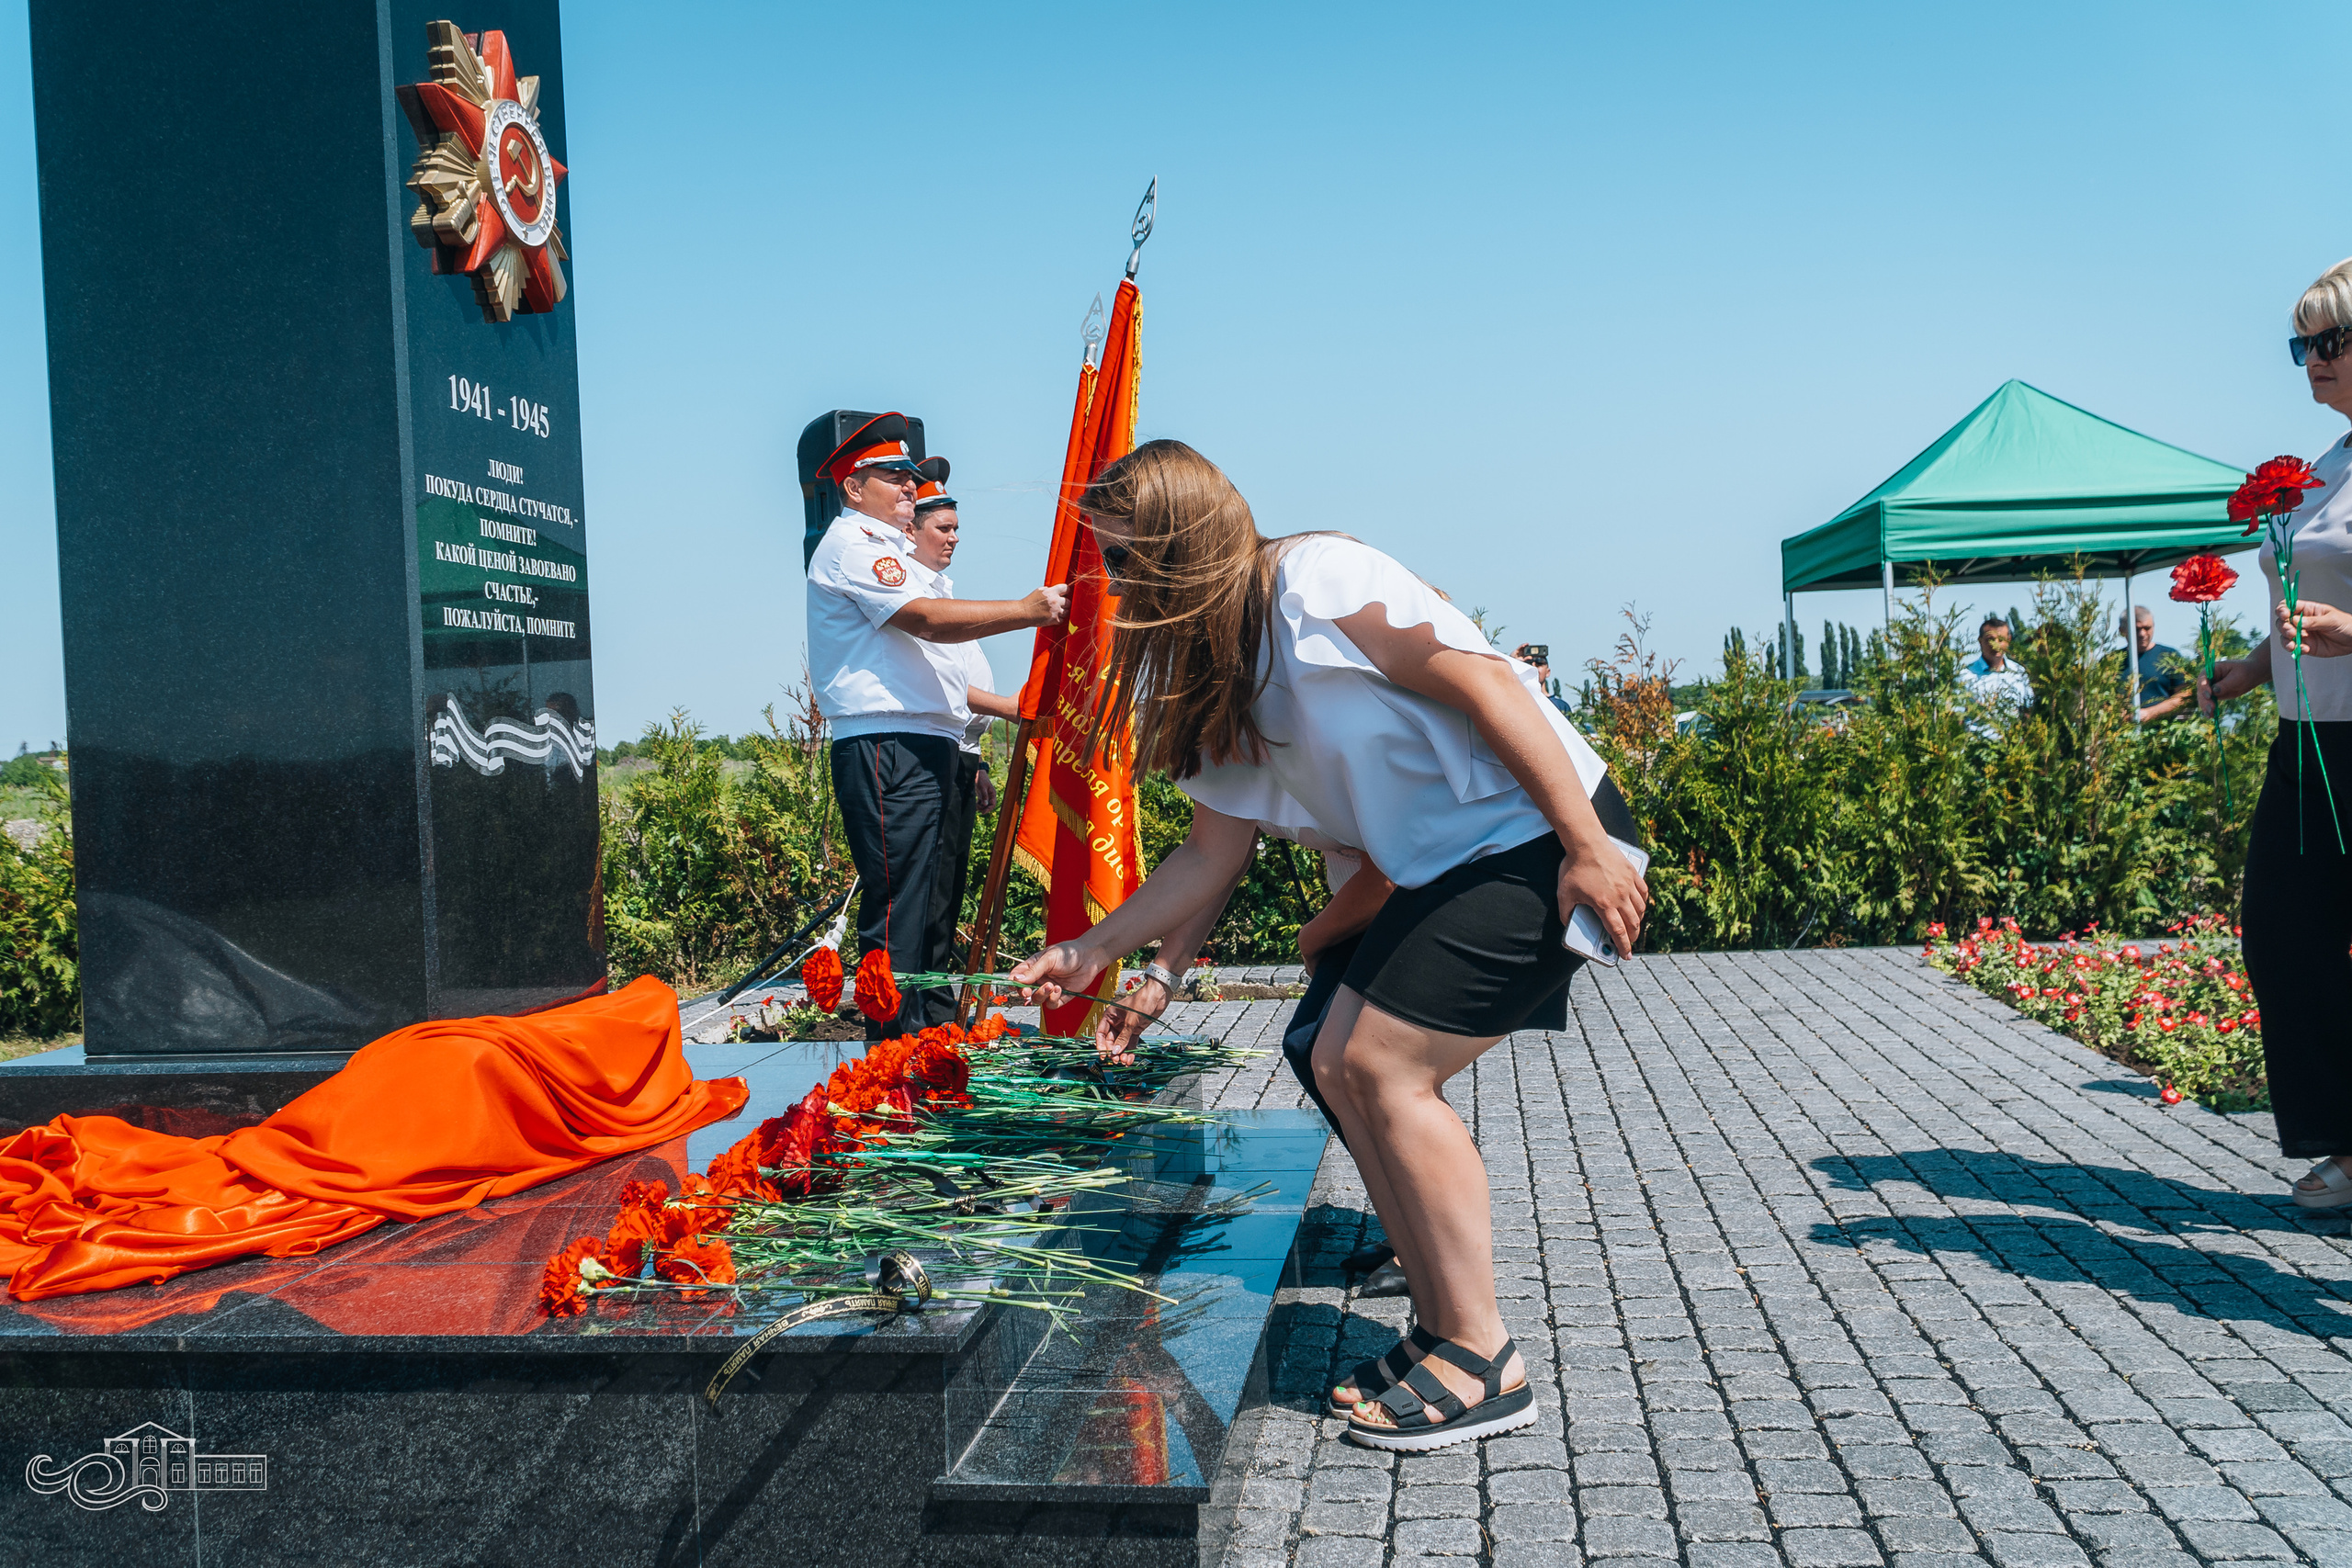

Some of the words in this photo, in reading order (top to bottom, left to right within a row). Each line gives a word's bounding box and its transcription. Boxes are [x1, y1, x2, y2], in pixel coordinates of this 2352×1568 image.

[448, 374, 492, 422] 1941
[497, 408, 505, 417] -
[510, 395, 550, 438] 1945
[487, 458, 524, 486] ЛЮДИ!
[424, 473, 474, 505] ПОКУДА
[475, 486, 517, 515] СЕРДЦА
[480, 518, 537, 547] ПОМНИТЕ!
[435, 540, 477, 566] КАКОЙ
[478, 550, 517, 572] ЦЕНОЙ
[518, 556, 577, 582] ЗАВОЕВАНО
[443, 606, 526, 637] ПОЖАЛУЙСТА,
[526, 616, 576, 639] ПОМНИТЕ
[844, 1298, 876, 1308] ПАМЯТЬ
[752, 1318, 789, 1348] ВЕЧНАЯ
[723, 1345, 752, 1376] ПАМЯТЬ
